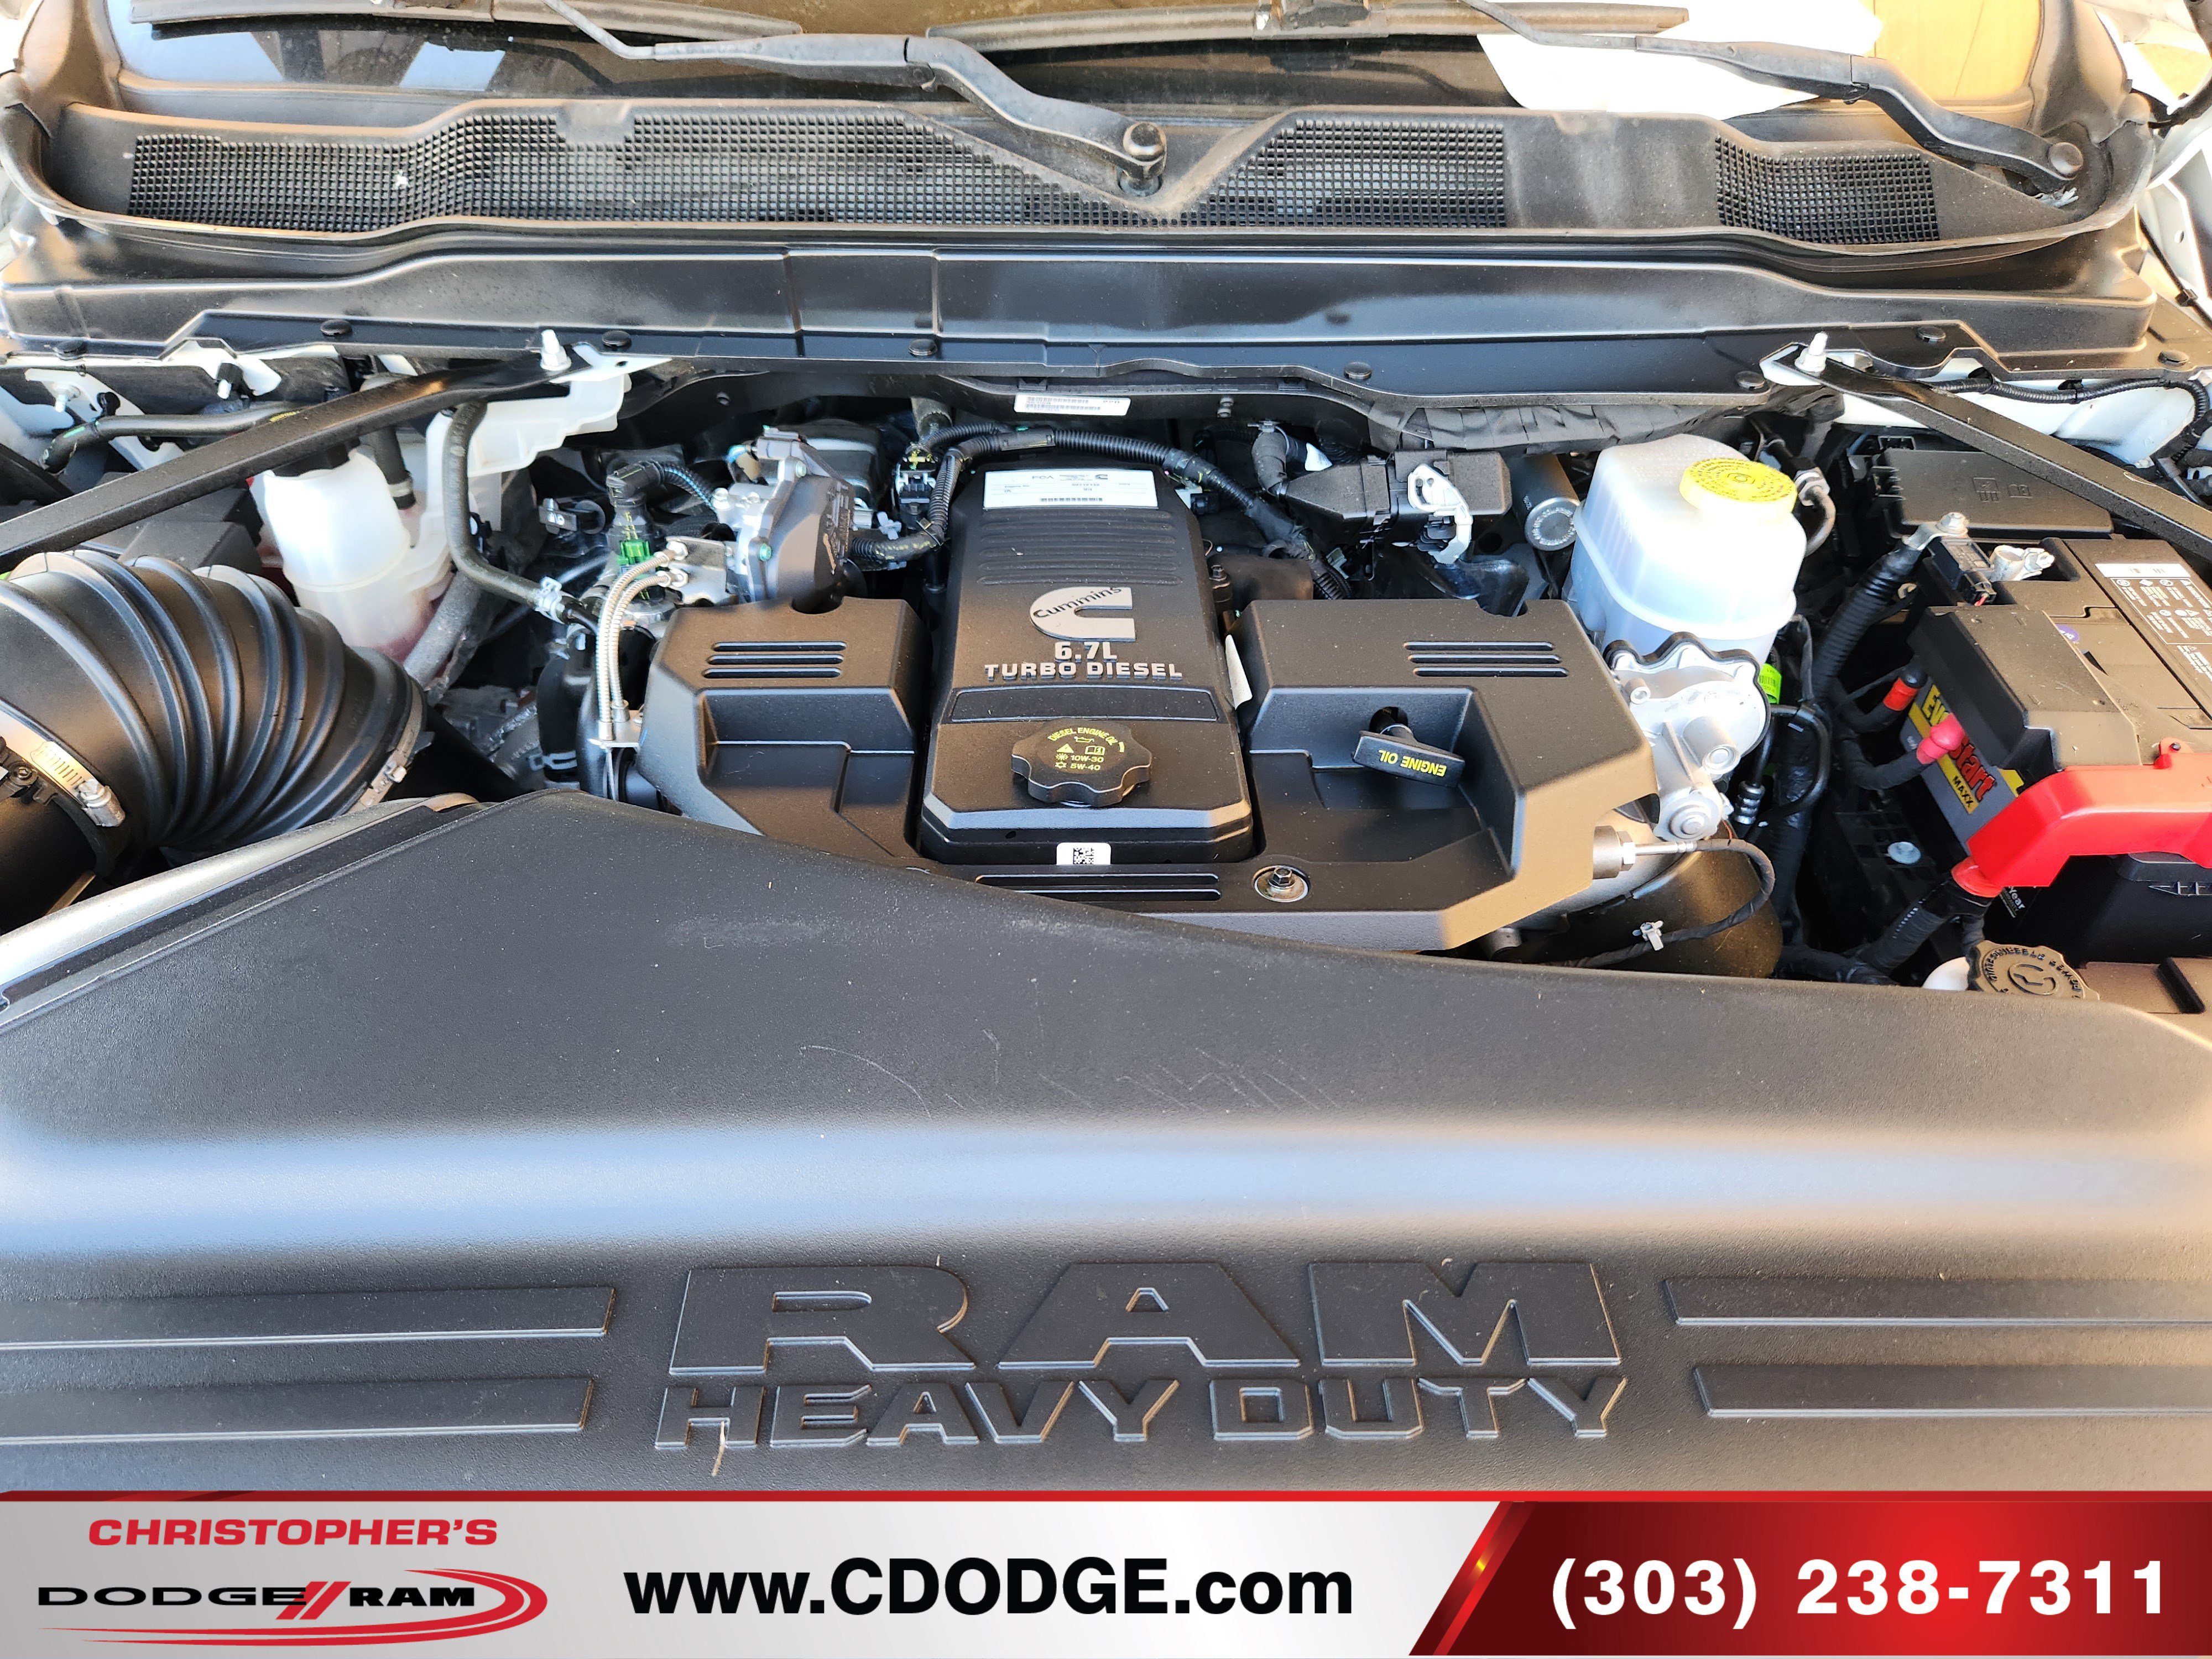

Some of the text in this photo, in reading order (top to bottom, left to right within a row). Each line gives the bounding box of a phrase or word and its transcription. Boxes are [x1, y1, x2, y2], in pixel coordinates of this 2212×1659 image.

[1033, 586, 1121, 618] Cummins
[1054, 641, 1118, 662] 6.7L
[985, 662, 1183, 680] TURBO DIESEL
[1047, 727, 1118, 746] DIESEL ENGINE OIL
[1378, 749, 1447, 777] ENGINE OIL
[1952, 775, 1975, 808] MAXX
[669, 1261, 1621, 1375] RAM
[655, 1377, 1628, 1449] HEAVY DUTY
